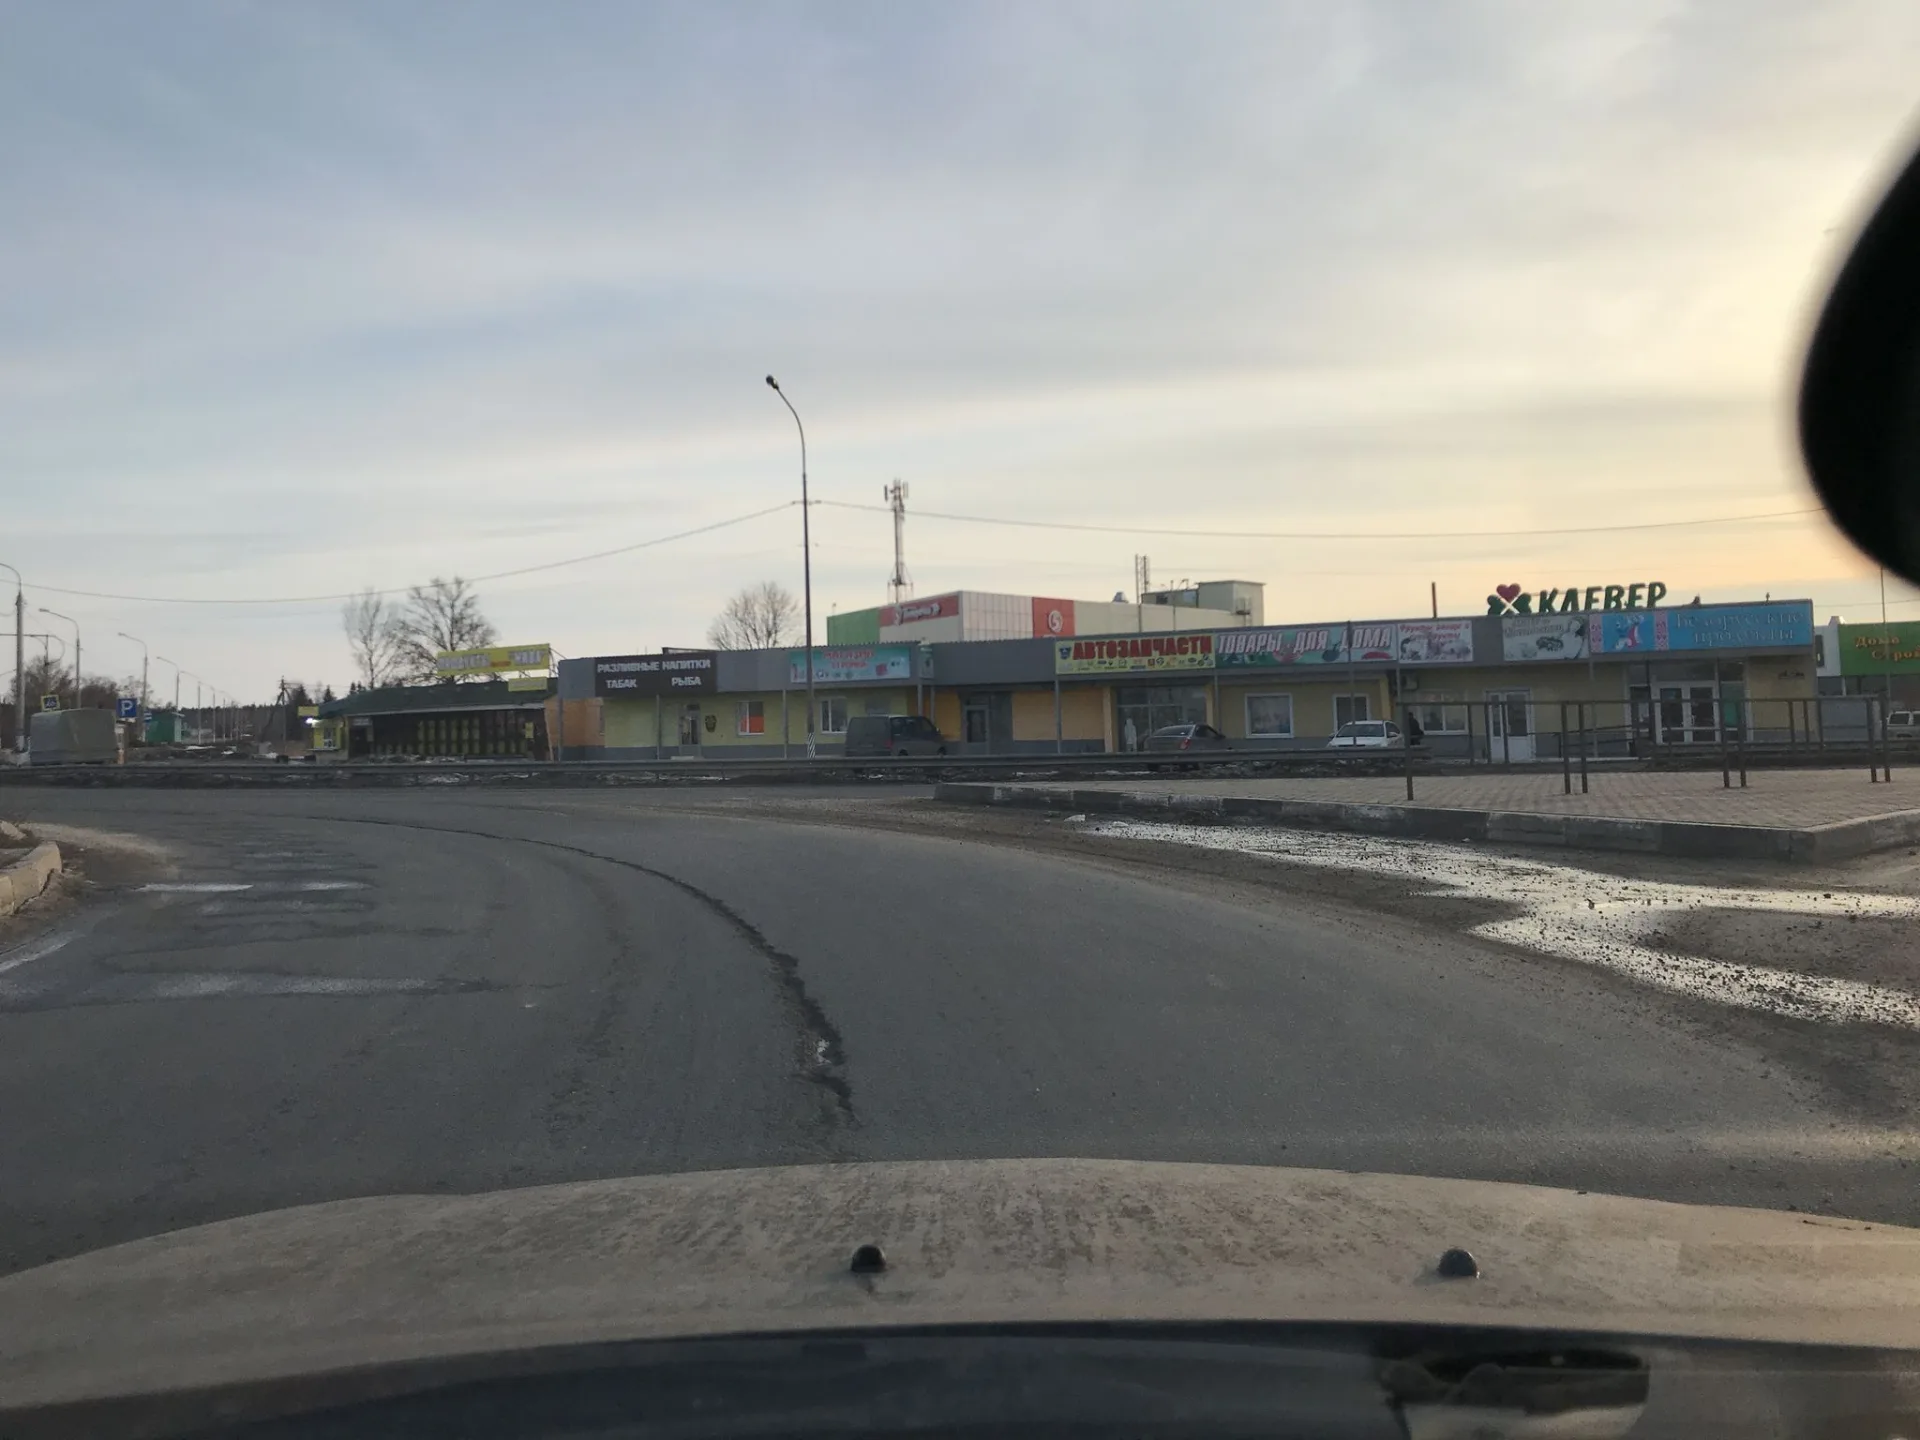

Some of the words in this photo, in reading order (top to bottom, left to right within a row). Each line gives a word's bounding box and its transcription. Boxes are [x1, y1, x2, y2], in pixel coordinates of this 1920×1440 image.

[1539, 582, 1667, 613] КЛЕВЕР
[1072, 636, 1213, 660] АВТОЗАПЧАСТИ
[1218, 632, 1283, 653] ТОВАРЫ
[1294, 630, 1329, 653] ДЛЯ
[597, 661, 660, 673] РАЗЛИВНЫЕ
[662, 659, 711, 671] НАПИТКИ
[605, 678, 637, 689] ТАБАК
[672, 676, 701, 687] РЫБА
